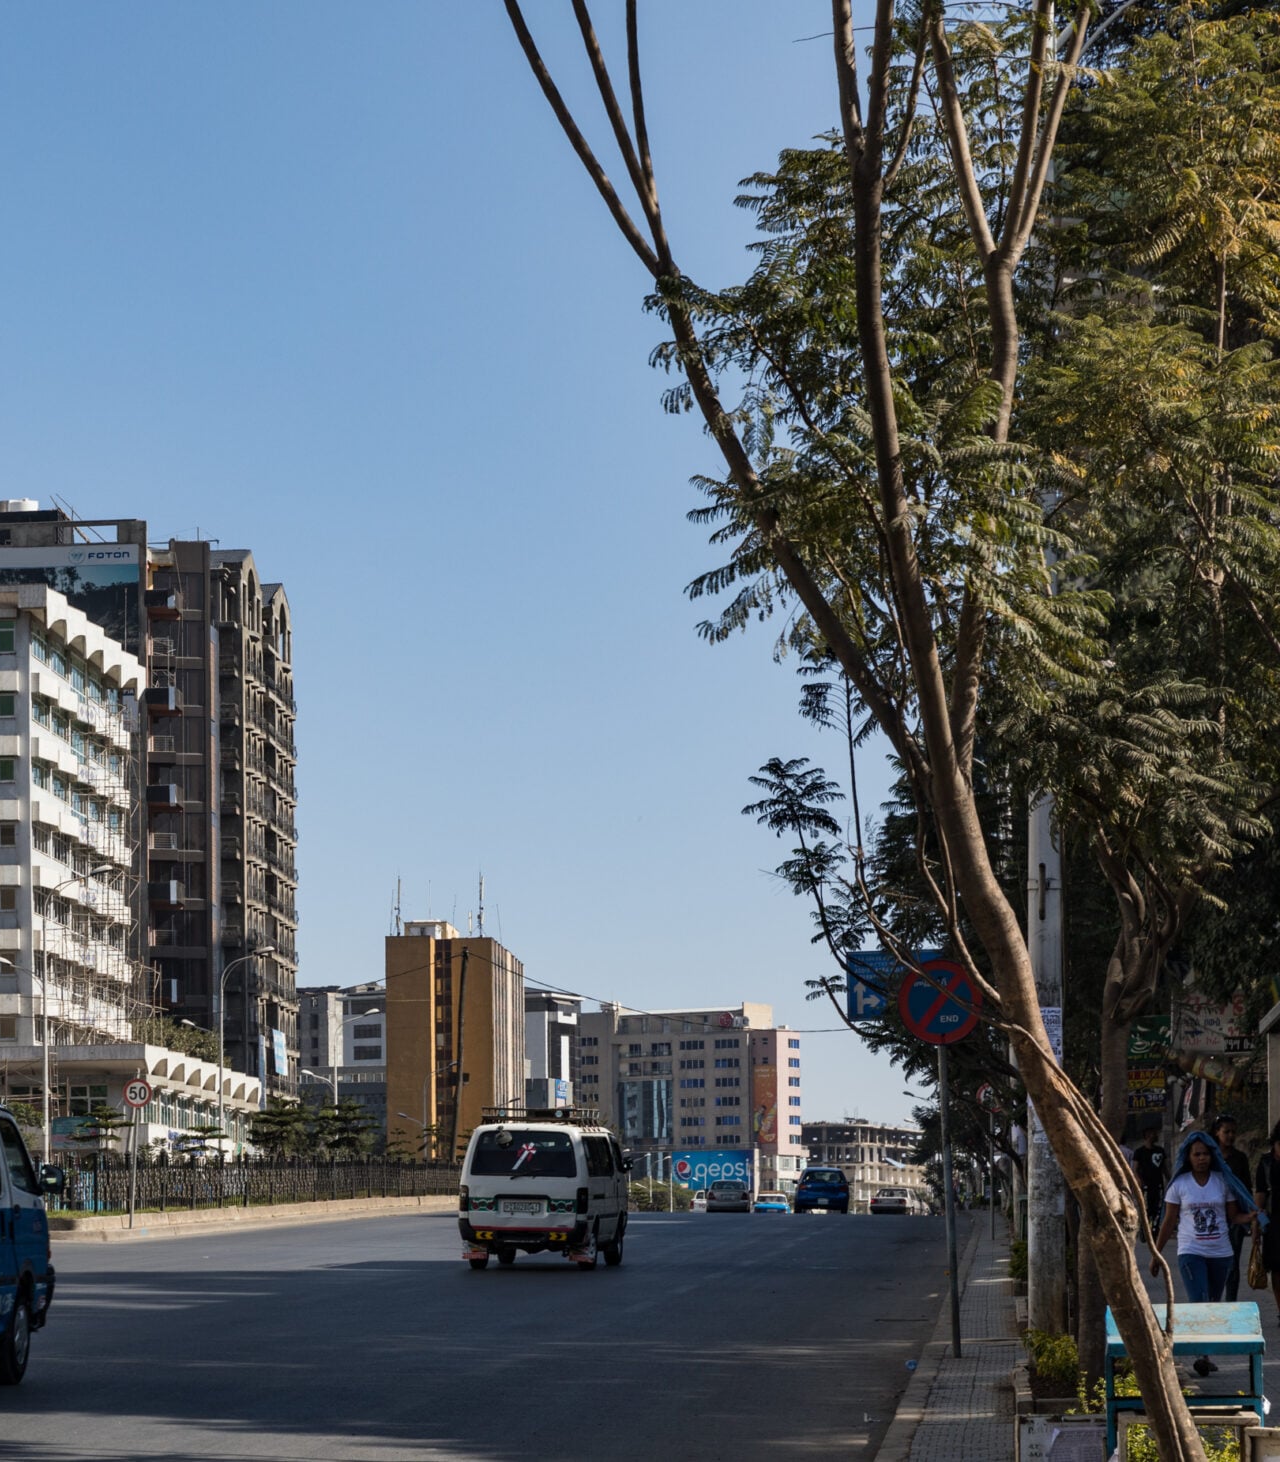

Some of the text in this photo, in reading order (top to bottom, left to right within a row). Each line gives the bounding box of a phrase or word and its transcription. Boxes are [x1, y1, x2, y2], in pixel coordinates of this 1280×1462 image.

[88, 551, 130, 560] FOTON
[939, 1015, 959, 1024] END
[129, 1086, 147, 1100] 50
[695, 1158, 749, 1181] pepsi
